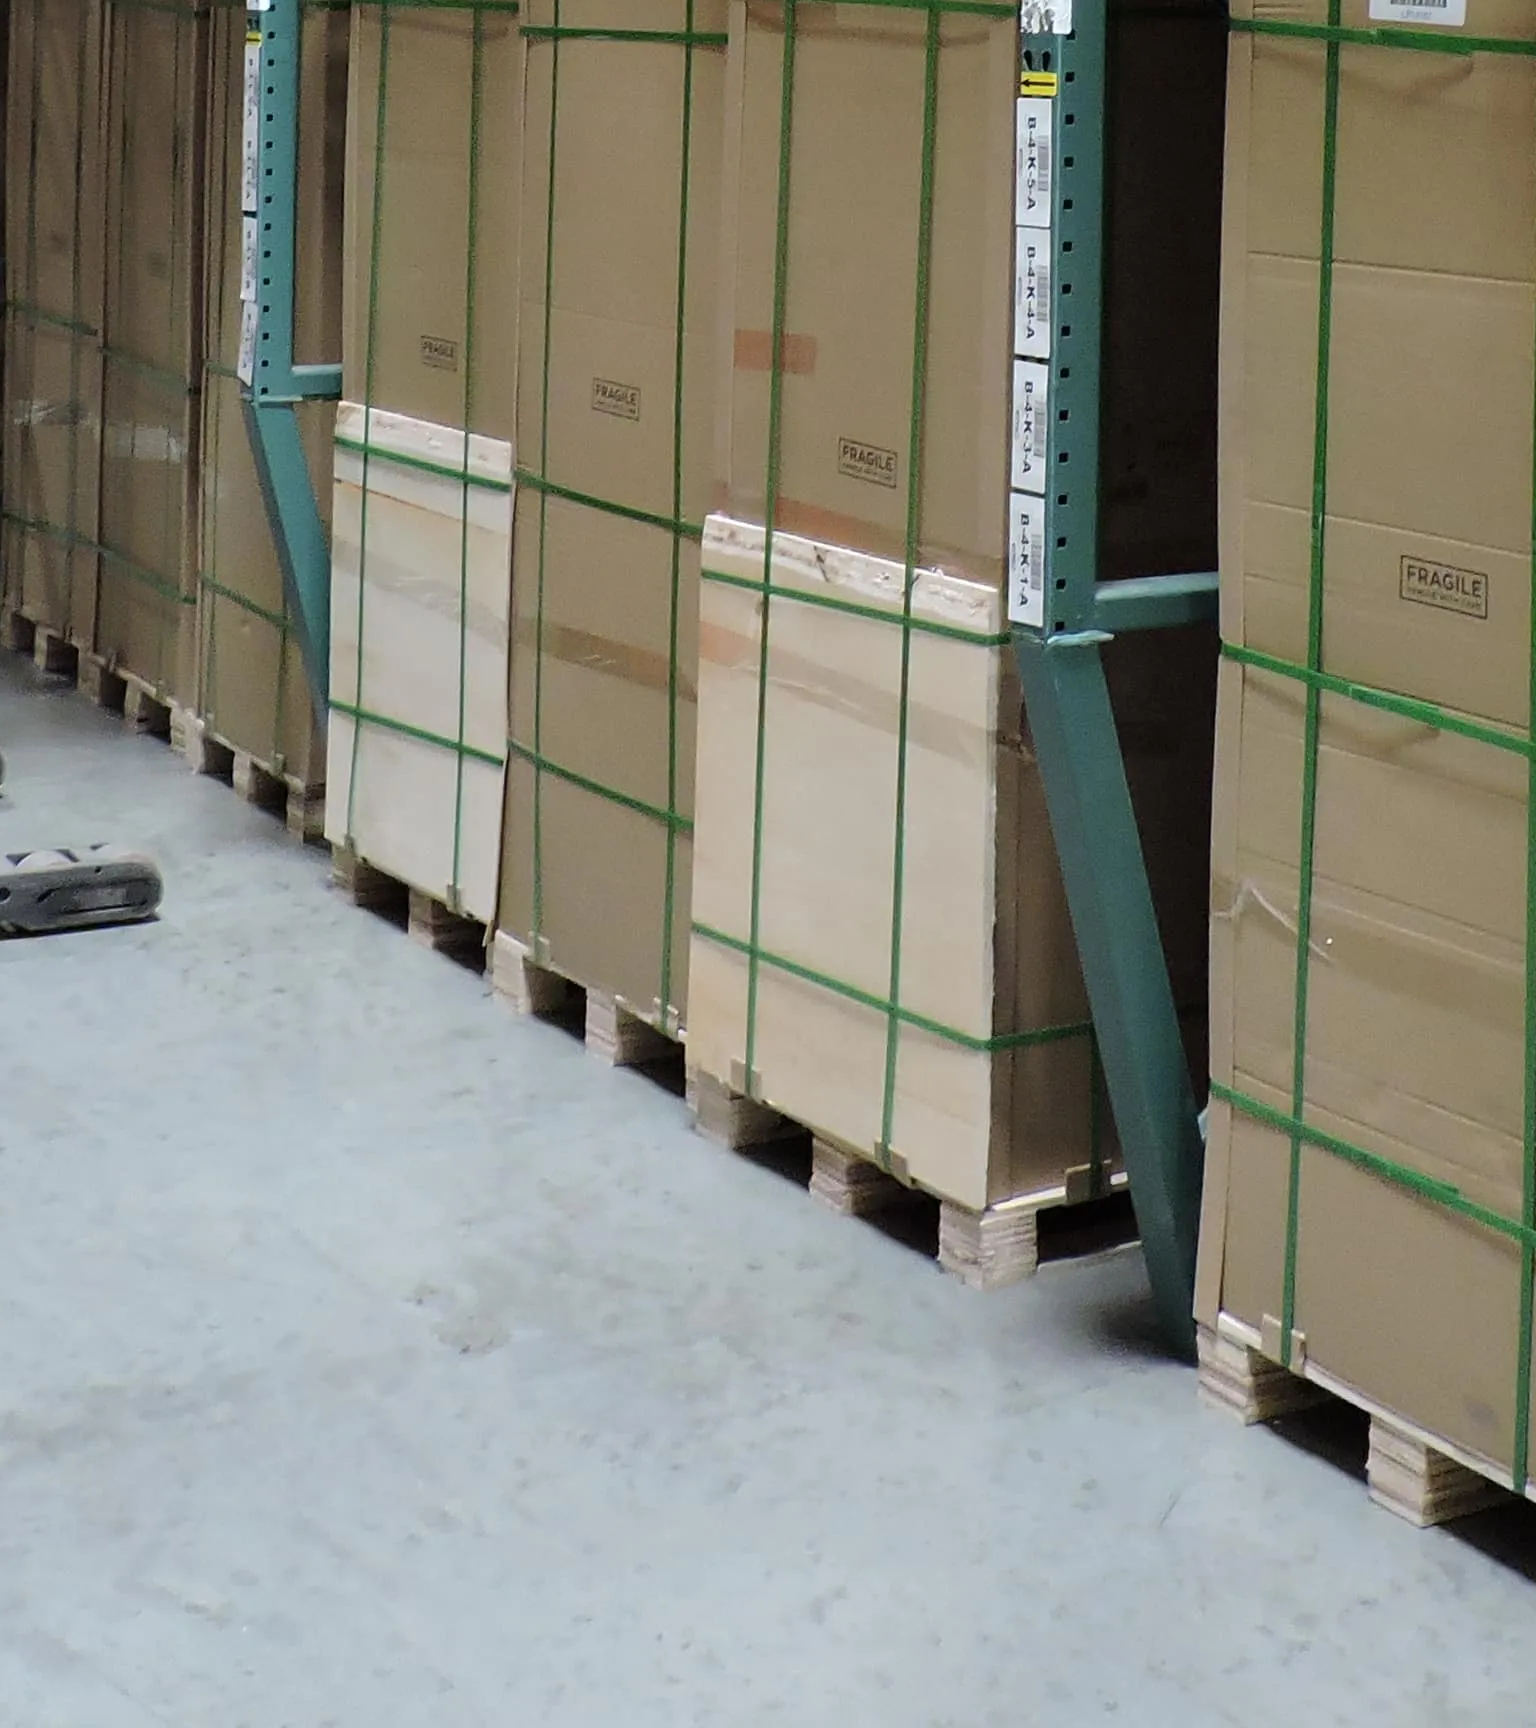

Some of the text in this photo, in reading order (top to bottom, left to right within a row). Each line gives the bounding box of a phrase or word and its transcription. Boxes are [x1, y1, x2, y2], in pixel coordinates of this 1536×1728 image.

[1027, 117, 1037, 210] B-4-K-5-A
[1026, 246, 1036, 340] B-4-K-4-A
[595, 383, 637, 406] FRAGILE
[1022, 381, 1034, 474] B-4-K-3-A
[843, 444, 894, 473] FRAGILE
[1019, 513, 1030, 607] B-4-K-1-A
[1407, 564, 1482, 598] FRAGILE
